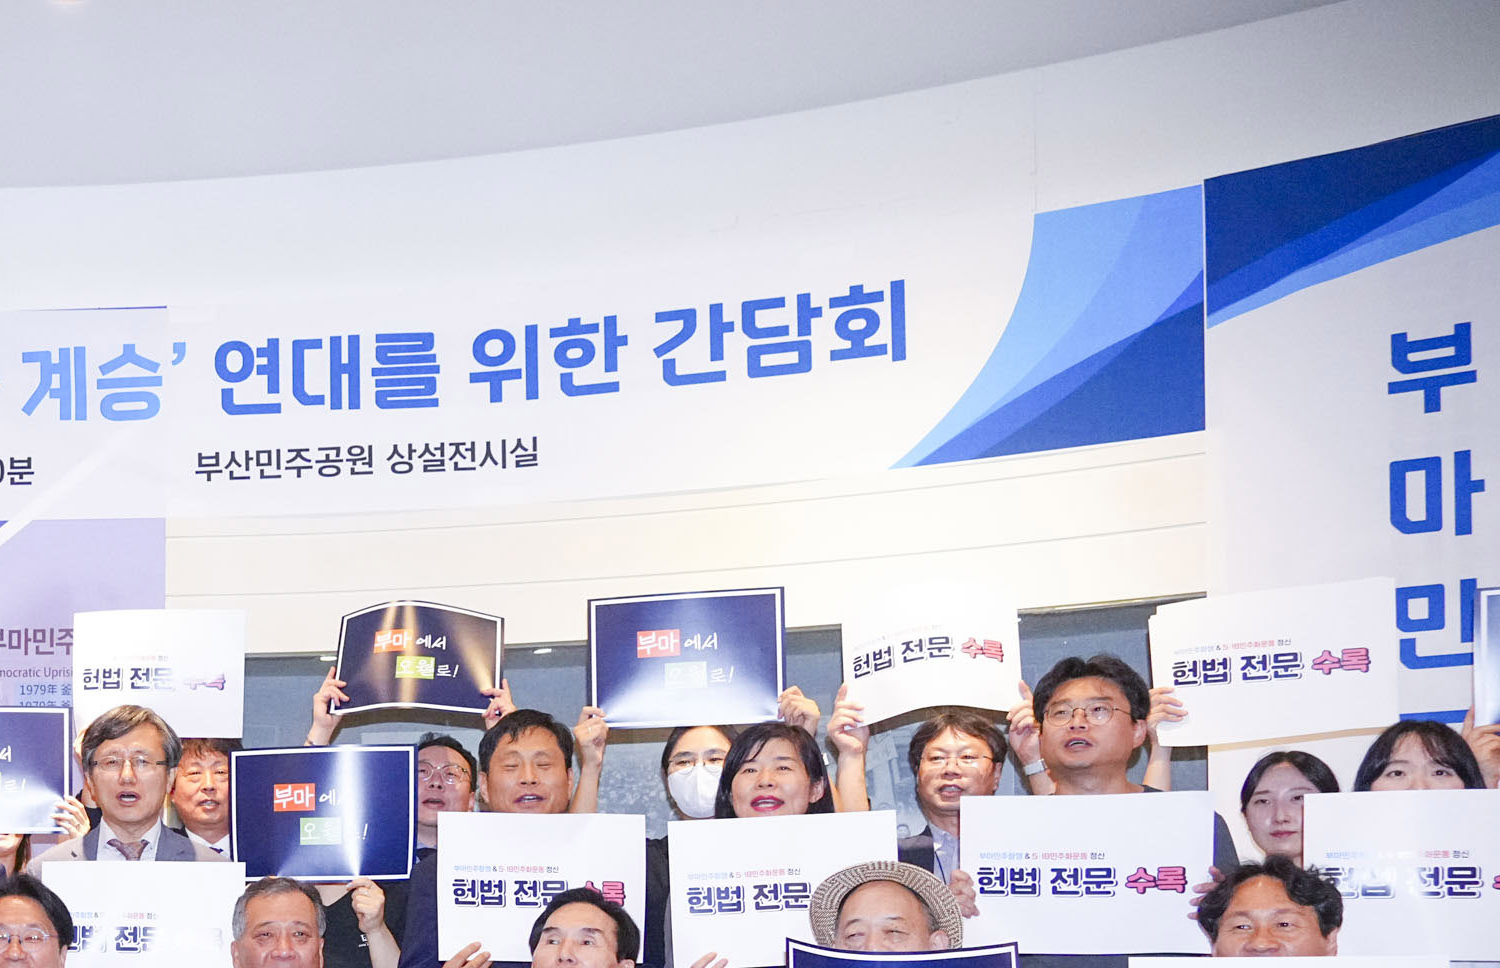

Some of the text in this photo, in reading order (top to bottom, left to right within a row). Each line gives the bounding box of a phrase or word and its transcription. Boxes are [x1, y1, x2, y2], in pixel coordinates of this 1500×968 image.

[214, 331, 441, 416] 연대를
[468, 314, 628, 403] 위한
[652, 278, 907, 387] 간담회
[195, 435, 539, 482] 부산민주공원 상설전시실
[1388, 321, 1485, 724] 부마민
[853, 645, 894, 679] 헌법
[901, 636, 953, 663] 전문
[961, 637, 1004, 663] 수록
[1172, 647, 1371, 686] 헌법 전문 수록
[20, 684, 58, 696] 1979年
[83, 668, 123, 690] 헌법
[452, 879, 506, 907] 헌법
[687, 882, 811, 914] 헌법 전문
[977, 866, 1188, 897] 헌법 전문 수록
